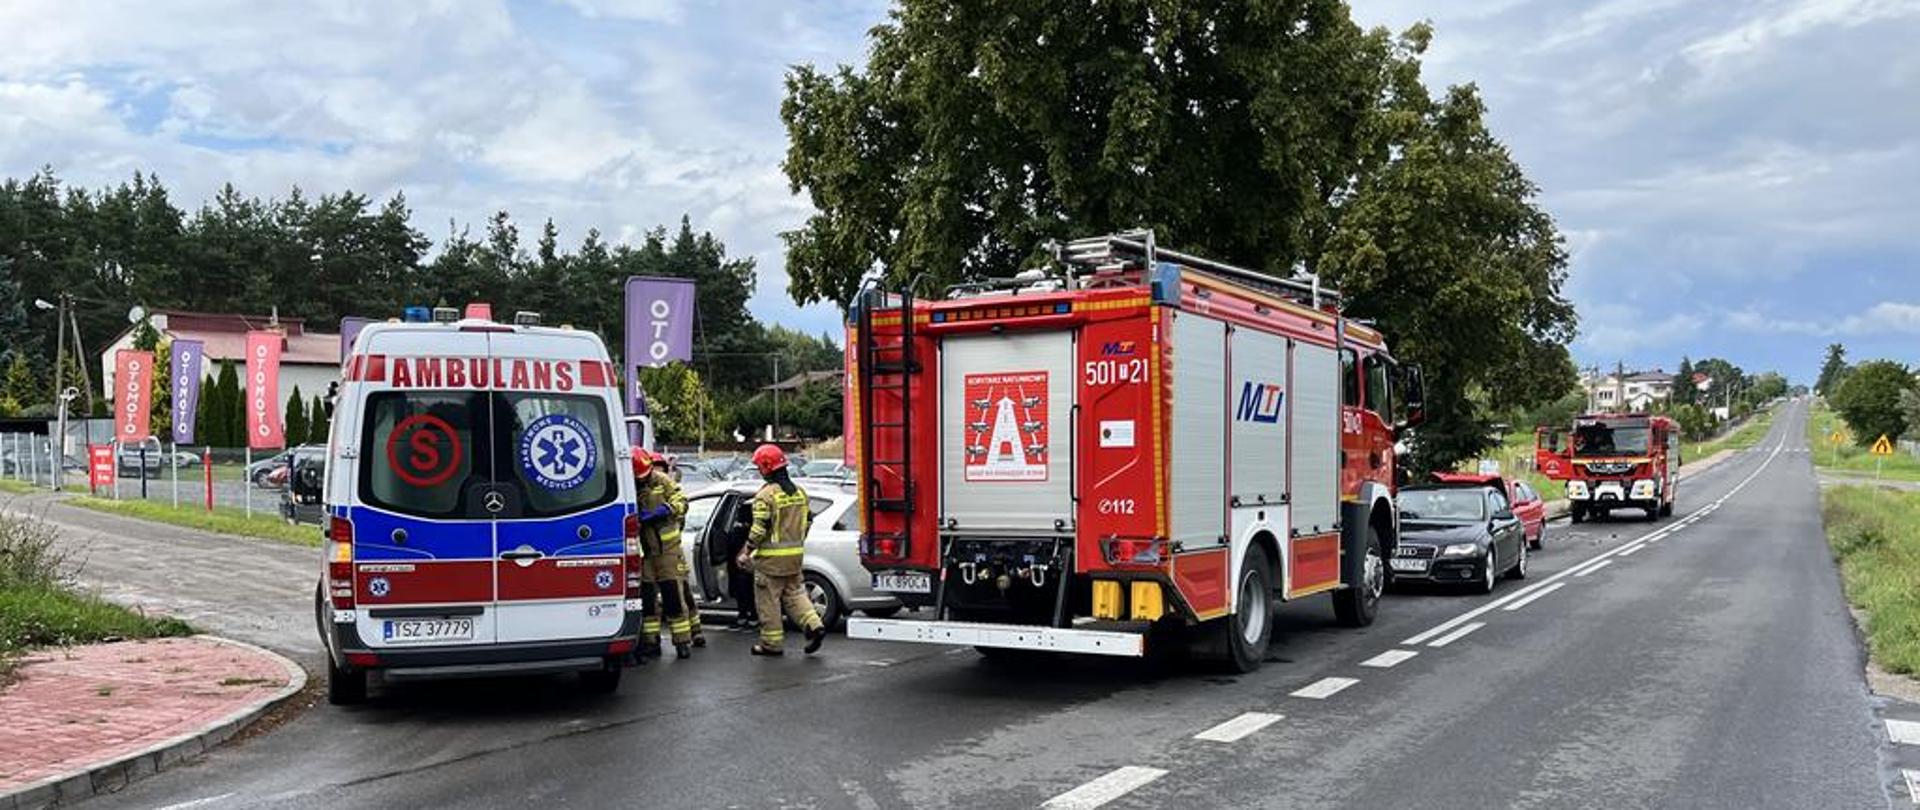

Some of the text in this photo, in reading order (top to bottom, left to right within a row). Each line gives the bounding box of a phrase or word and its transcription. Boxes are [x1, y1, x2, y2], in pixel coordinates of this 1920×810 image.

[178, 351, 191, 433] OTOMOTO
[255, 345, 270, 437] OTOMOTO
[392, 357, 574, 392] AMBULANS
[125, 360, 140, 434] OTOMOTO
[409, 429, 440, 471] S
[535, 474, 585, 490] MEDYCZNE
[1113, 498, 1135, 514] 112
[395, 620, 470, 637] TSZ 37779
